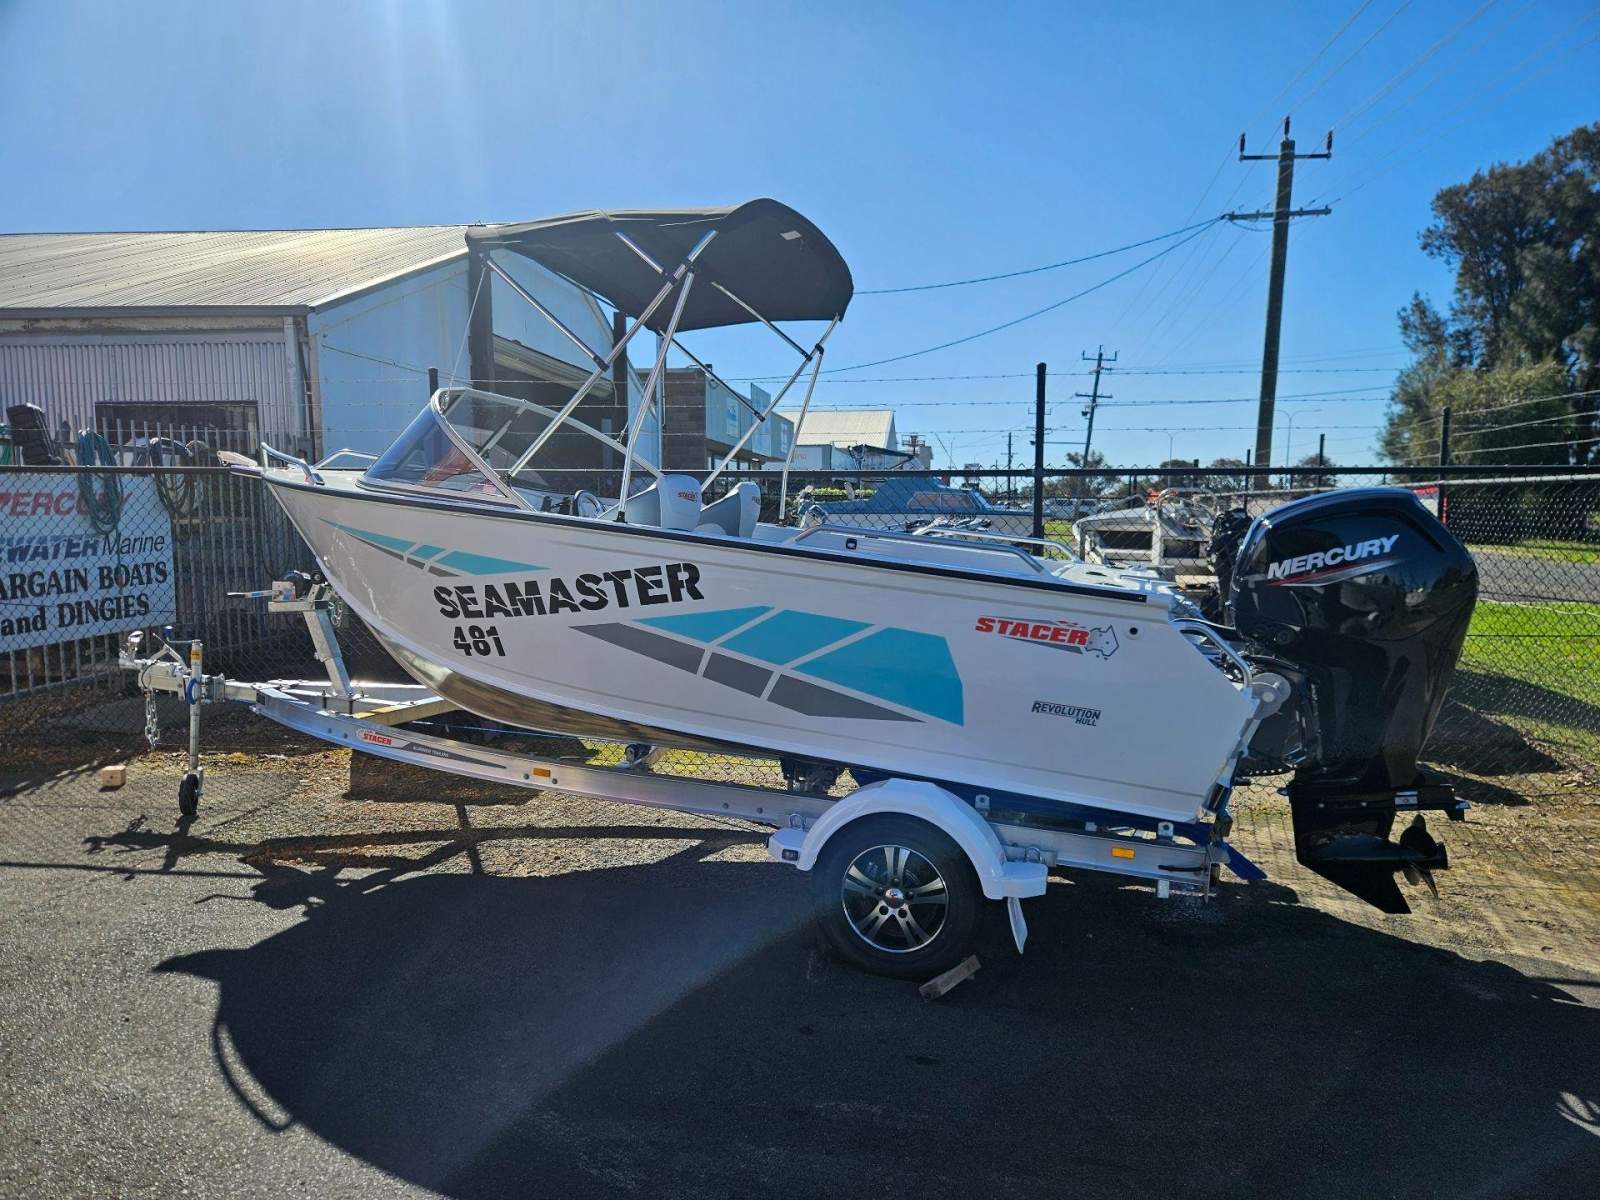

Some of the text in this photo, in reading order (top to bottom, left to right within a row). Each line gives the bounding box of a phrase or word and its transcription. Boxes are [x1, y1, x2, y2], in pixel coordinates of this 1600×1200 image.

[0, 534, 165, 563] WATER Marine
[1267, 534, 1400, 579] MERCURY
[98, 561, 168, 590] BOATS
[433, 562, 705, 619] SEAMASTER
[0, 593, 150, 636] and DINGIES
[453, 625, 506, 657] 481
[975, 616, 1090, 646] STACER
[1031, 700, 1101, 720] REVOLUTION
[1075, 718, 1097, 727] HULL
